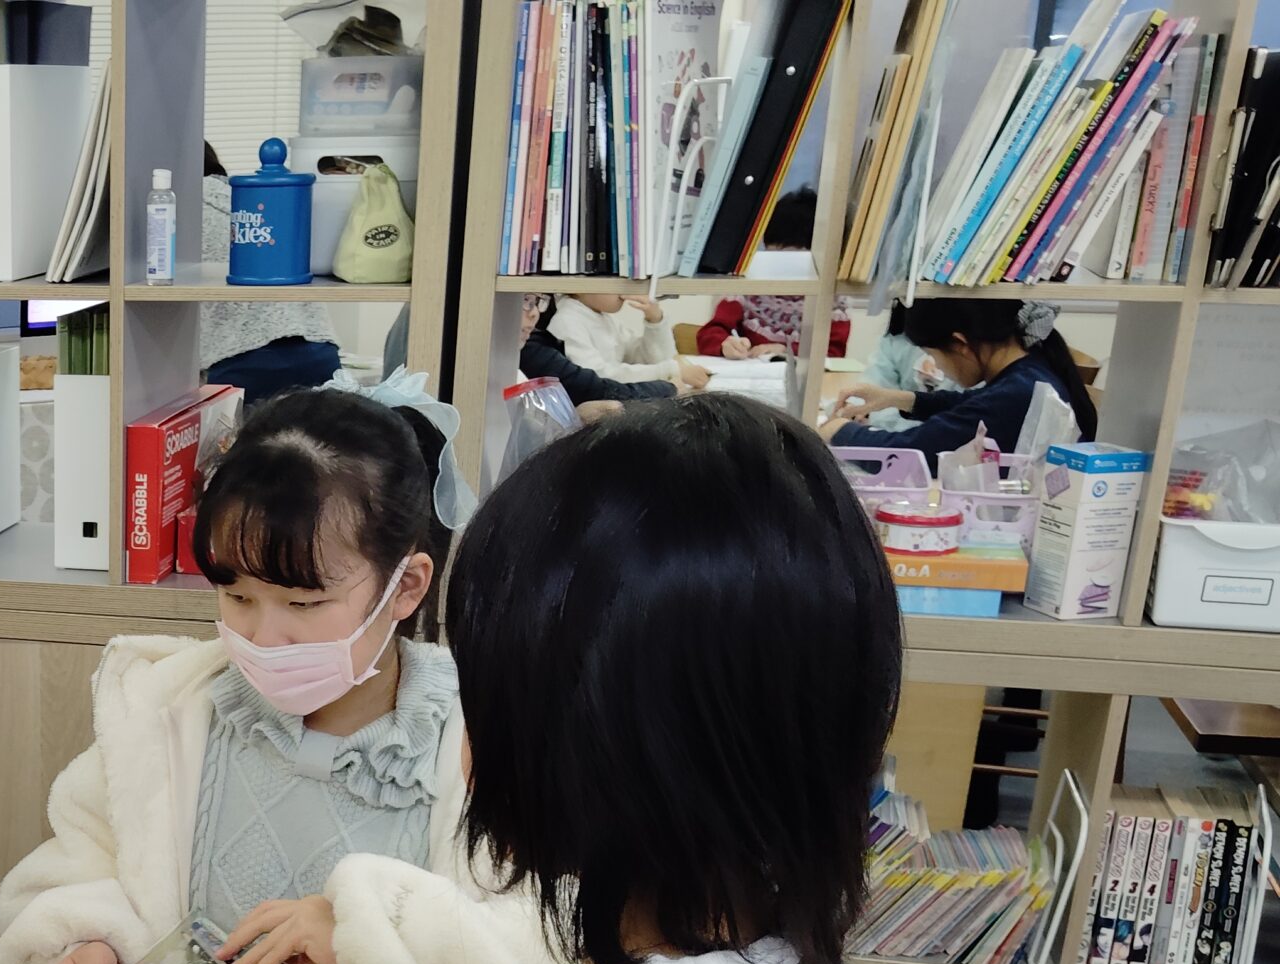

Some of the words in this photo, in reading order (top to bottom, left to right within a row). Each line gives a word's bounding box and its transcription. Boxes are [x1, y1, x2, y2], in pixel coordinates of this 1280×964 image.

[1110, 170, 1125, 190] Today
[1093, 194, 1111, 219] Monday
[1144, 182, 1159, 214] YUCKY
[166, 422, 200, 457] SCRABBLE
[134, 472, 148, 546] SCRABBLE
[894, 563, 932, 579] Q&A
[1212, 831, 1226, 859] DEMON
[1232, 836, 1247, 865] DEMON
[1109, 879, 1120, 892] 2
[1208, 859, 1223, 887] SLAYER
[1228, 865, 1243, 893] SLAYER
[1129, 881, 1139, 894] 3
[1147, 884, 1157, 896] 4
